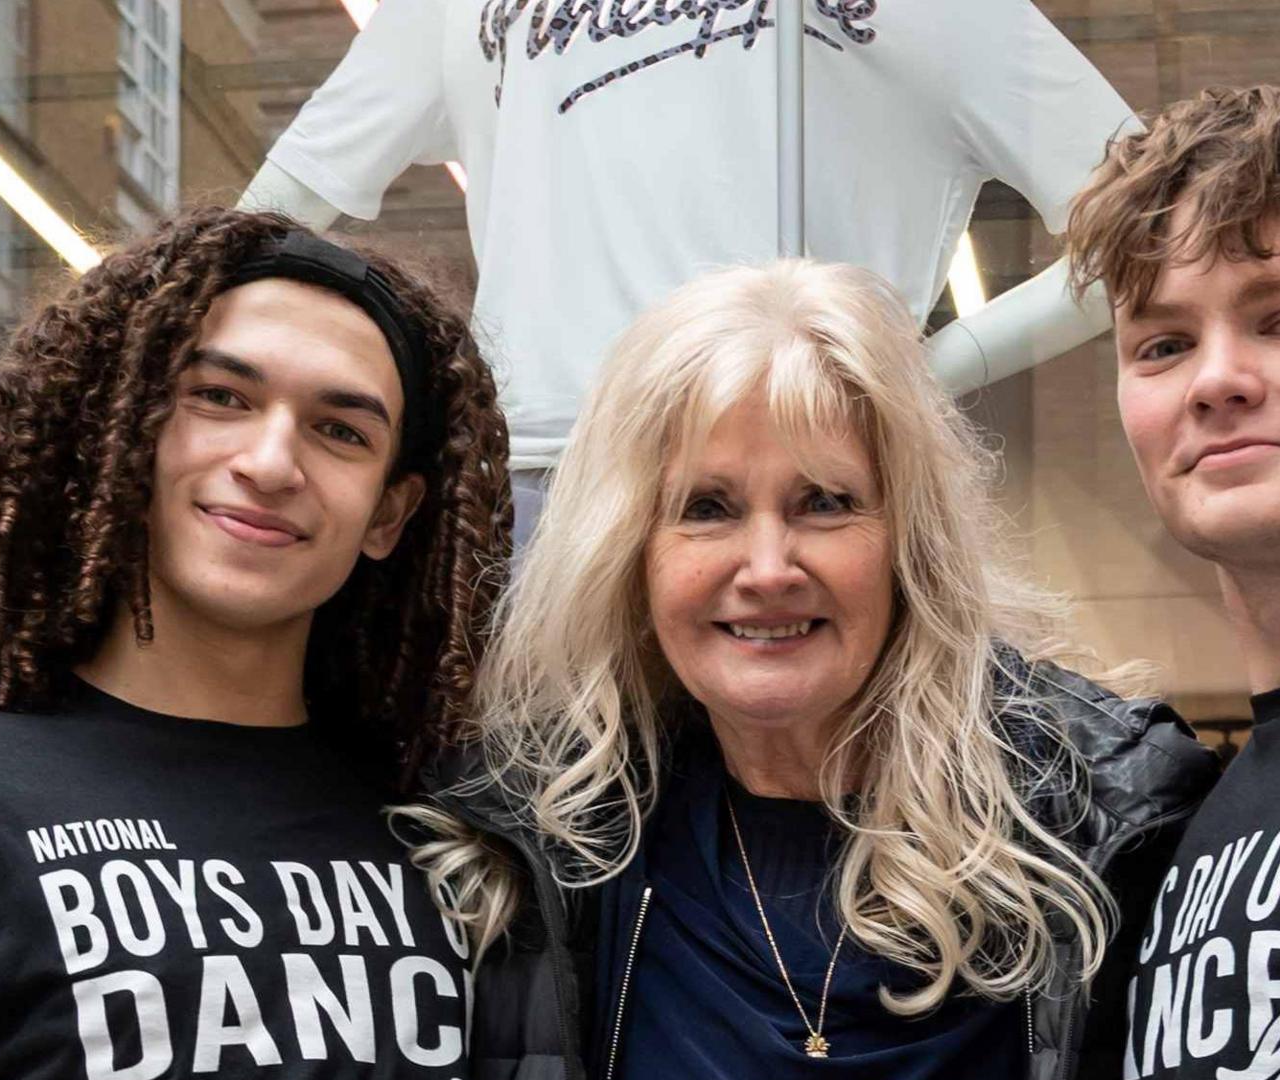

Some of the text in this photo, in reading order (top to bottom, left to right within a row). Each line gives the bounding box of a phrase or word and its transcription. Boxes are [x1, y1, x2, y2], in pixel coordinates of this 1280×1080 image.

[27, 818, 177, 863] NATIONAL
[1170, 830, 1264, 954] DAY
[38, 859, 264, 975] BOYS
[270, 860, 417, 948] DAY
